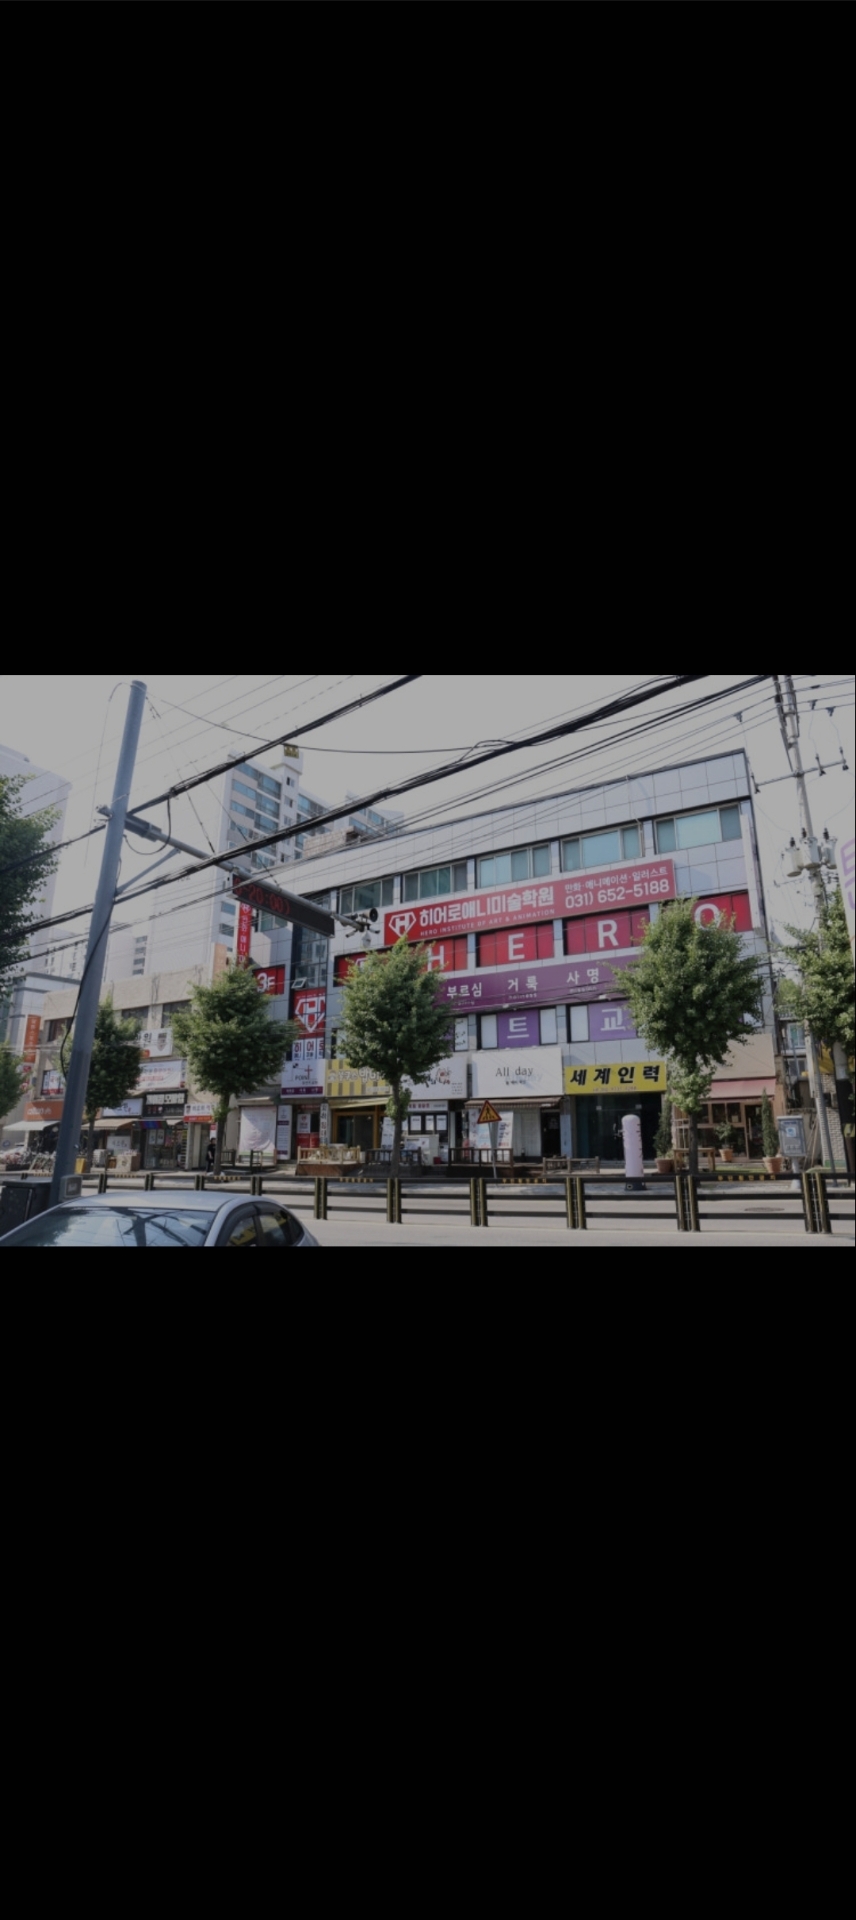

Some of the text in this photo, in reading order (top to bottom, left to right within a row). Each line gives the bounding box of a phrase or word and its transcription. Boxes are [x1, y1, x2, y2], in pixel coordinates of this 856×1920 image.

[419, 885, 554, 927] 히어로애니미술학원
[565, 879, 670, 909] 031) 652-5188
[420, 929, 438, 937] HERO
[440, 922, 474, 934] INSTITUTE
[489, 917, 502, 925] ART
[513, 909, 555, 921] ANIMATION
[427, 945, 444, 971] H
[508, 932, 525, 961] E
[597, 919, 619, 948] R
[257, 972, 275, 993] 3F
[446, 982, 482, 998] 부르심
[507, 1007, 626, 1039] 트 교
[495, 1065, 534, 1077] All day
[570, 1064, 660, 1086] 세계인력
